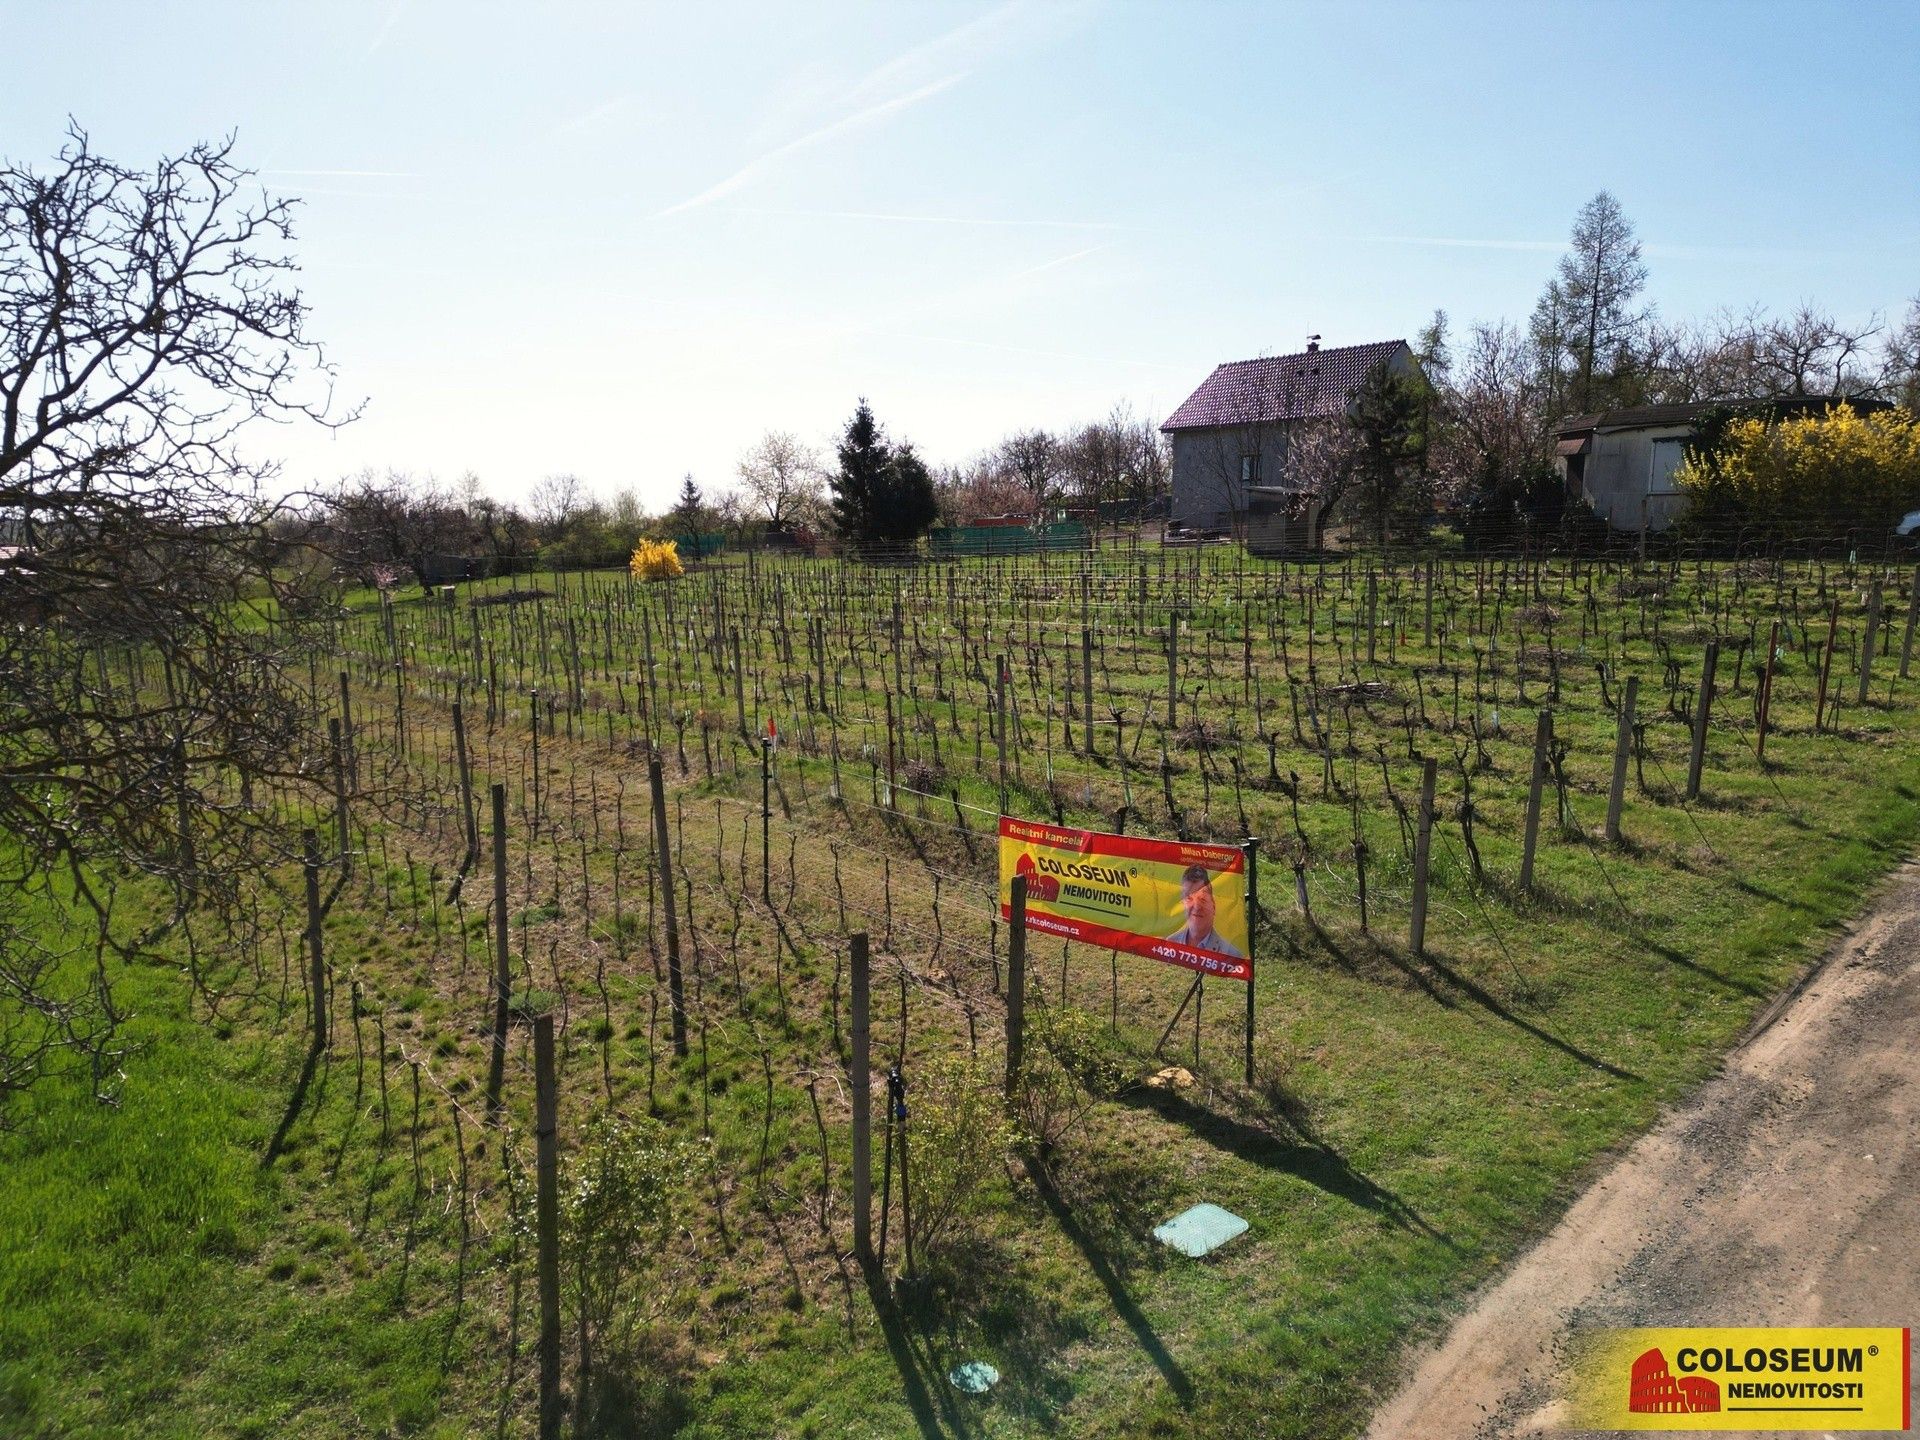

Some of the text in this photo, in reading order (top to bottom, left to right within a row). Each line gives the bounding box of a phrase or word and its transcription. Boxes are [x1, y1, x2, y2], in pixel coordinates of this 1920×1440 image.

[1181, 847, 1201, 857] Milan
[1063, 884, 1132, 908] NEMOVITOSTI
[1151, 946, 1176, 958] +420
[1178, 950, 1197, 964] 773
[1200, 956, 1218, 970] 756
